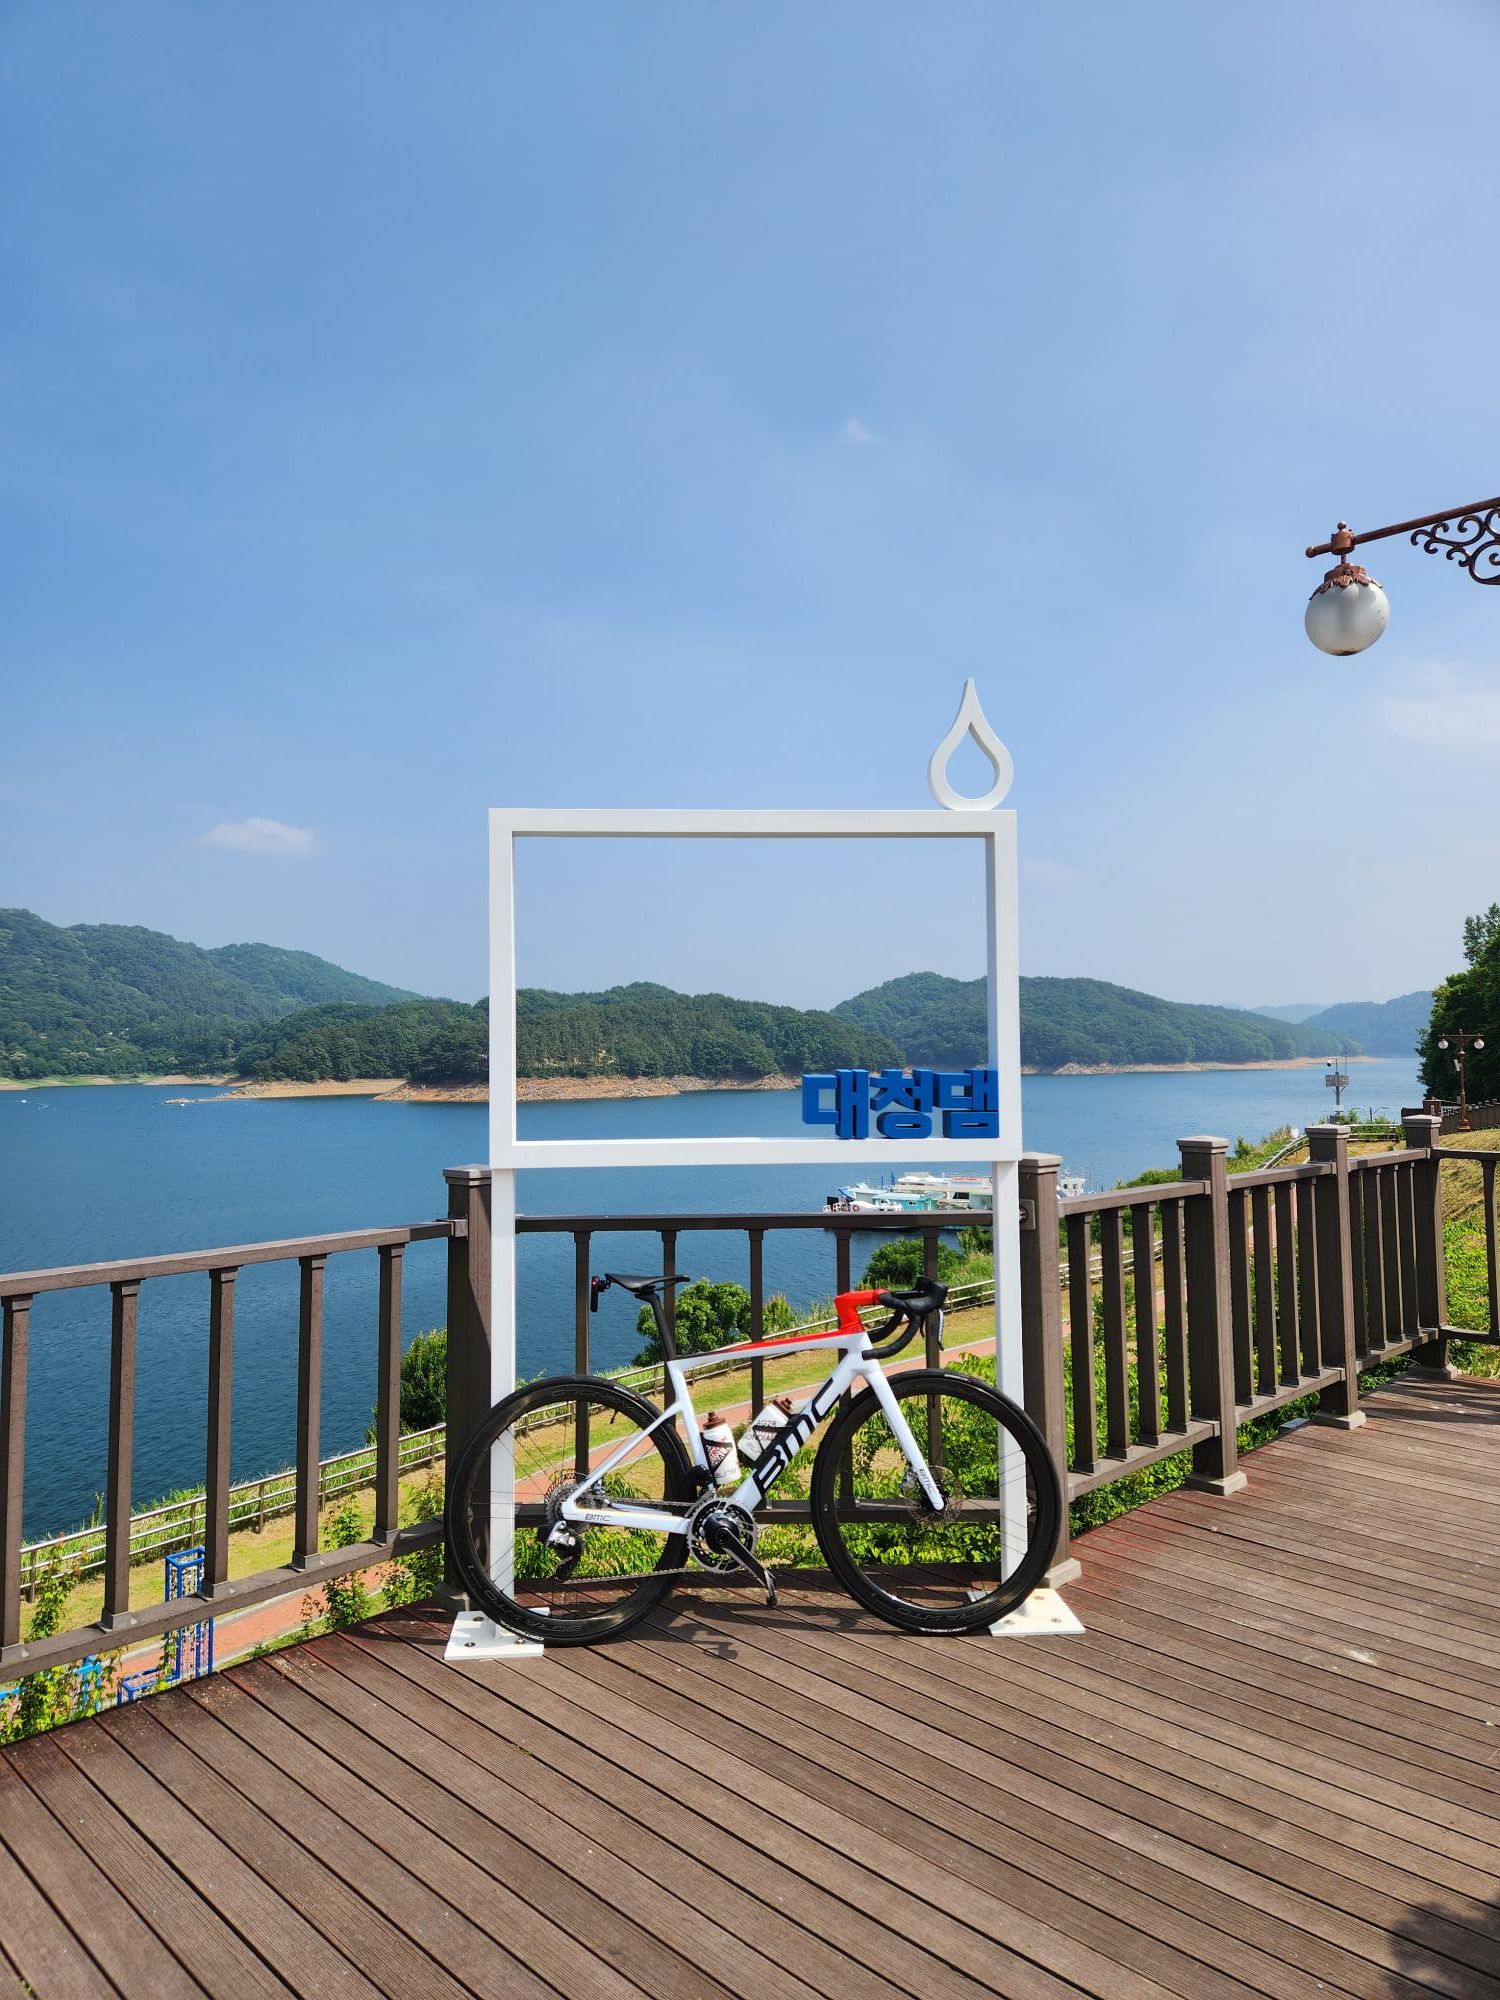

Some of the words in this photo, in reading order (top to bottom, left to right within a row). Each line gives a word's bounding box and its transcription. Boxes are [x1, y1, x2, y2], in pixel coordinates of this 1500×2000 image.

[802, 1068, 999, 1139] 대청댐
[753, 1377, 841, 1493] BMC
[585, 1513, 612, 1522] BMC
